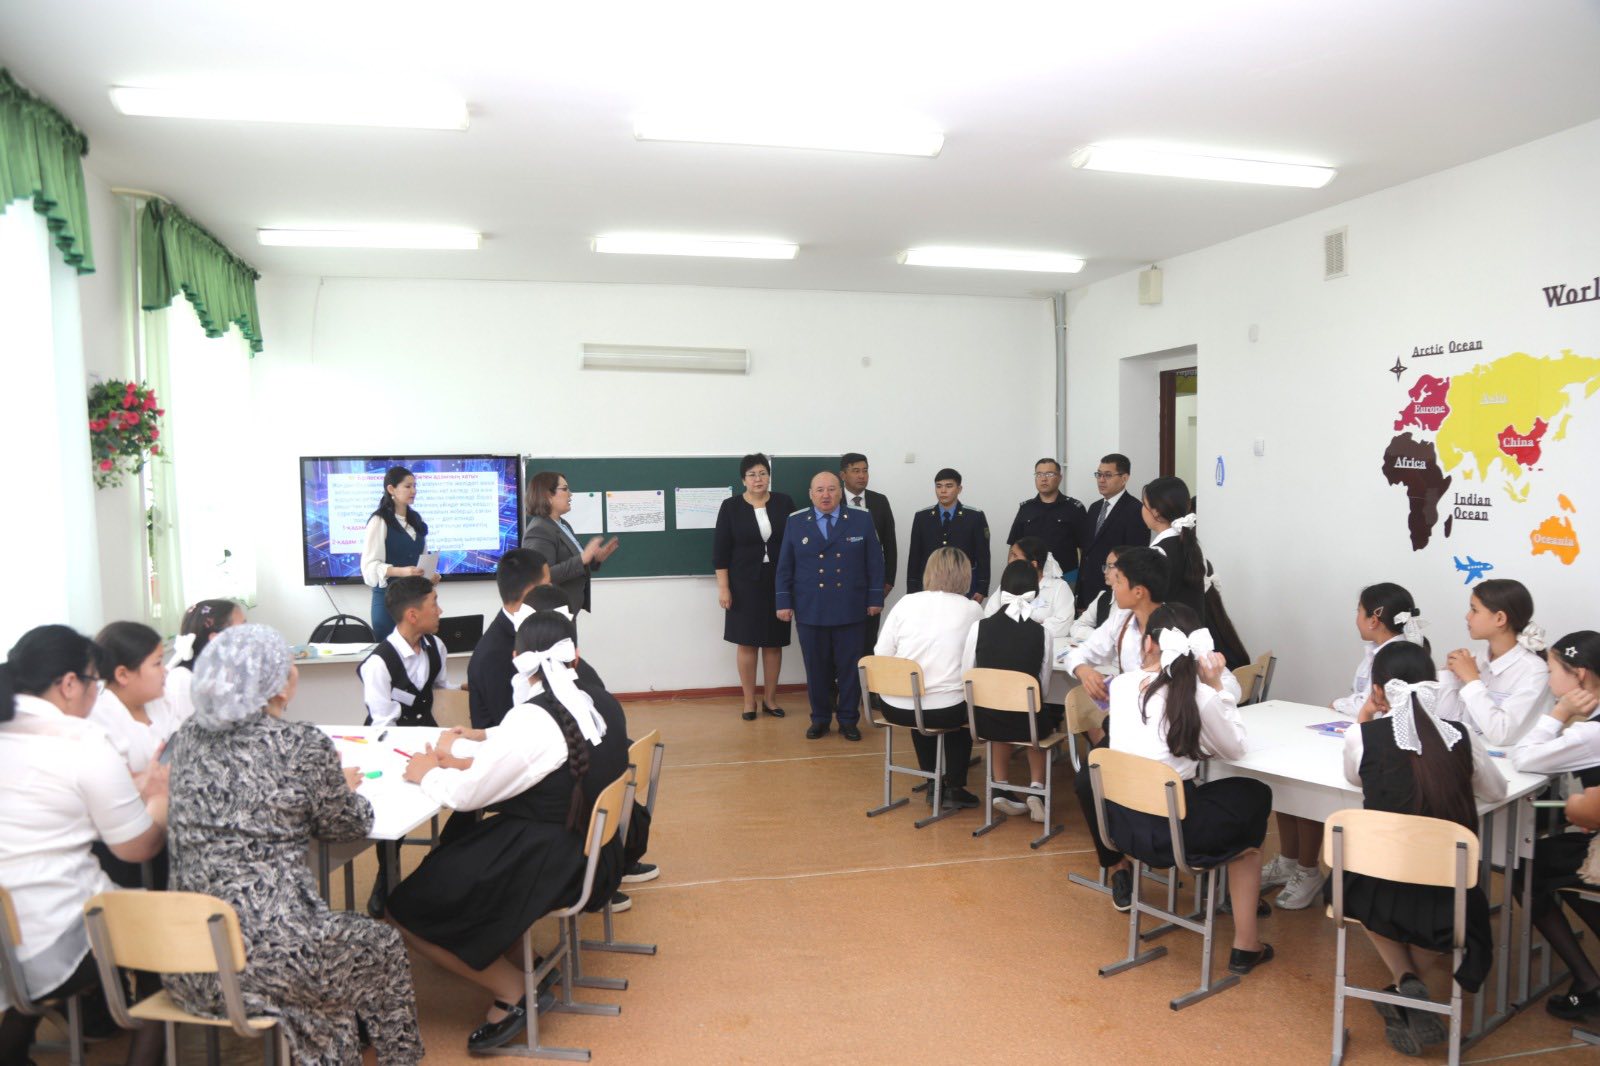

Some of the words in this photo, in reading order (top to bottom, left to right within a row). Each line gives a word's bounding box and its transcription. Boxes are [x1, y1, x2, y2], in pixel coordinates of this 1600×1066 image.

[1542, 277, 1600, 307] Worl
[1411, 345, 1444, 358] Arctic
[1449, 340, 1483, 353] Ocean
[1414, 405, 1446, 414] Europe
[1503, 437, 1534, 447] China
[1394, 457, 1427, 469] Africa
[1454, 492, 1492, 506] Indian
[1454, 507, 1489, 521] Ocean
[1533, 533, 1575, 547] Oceania
